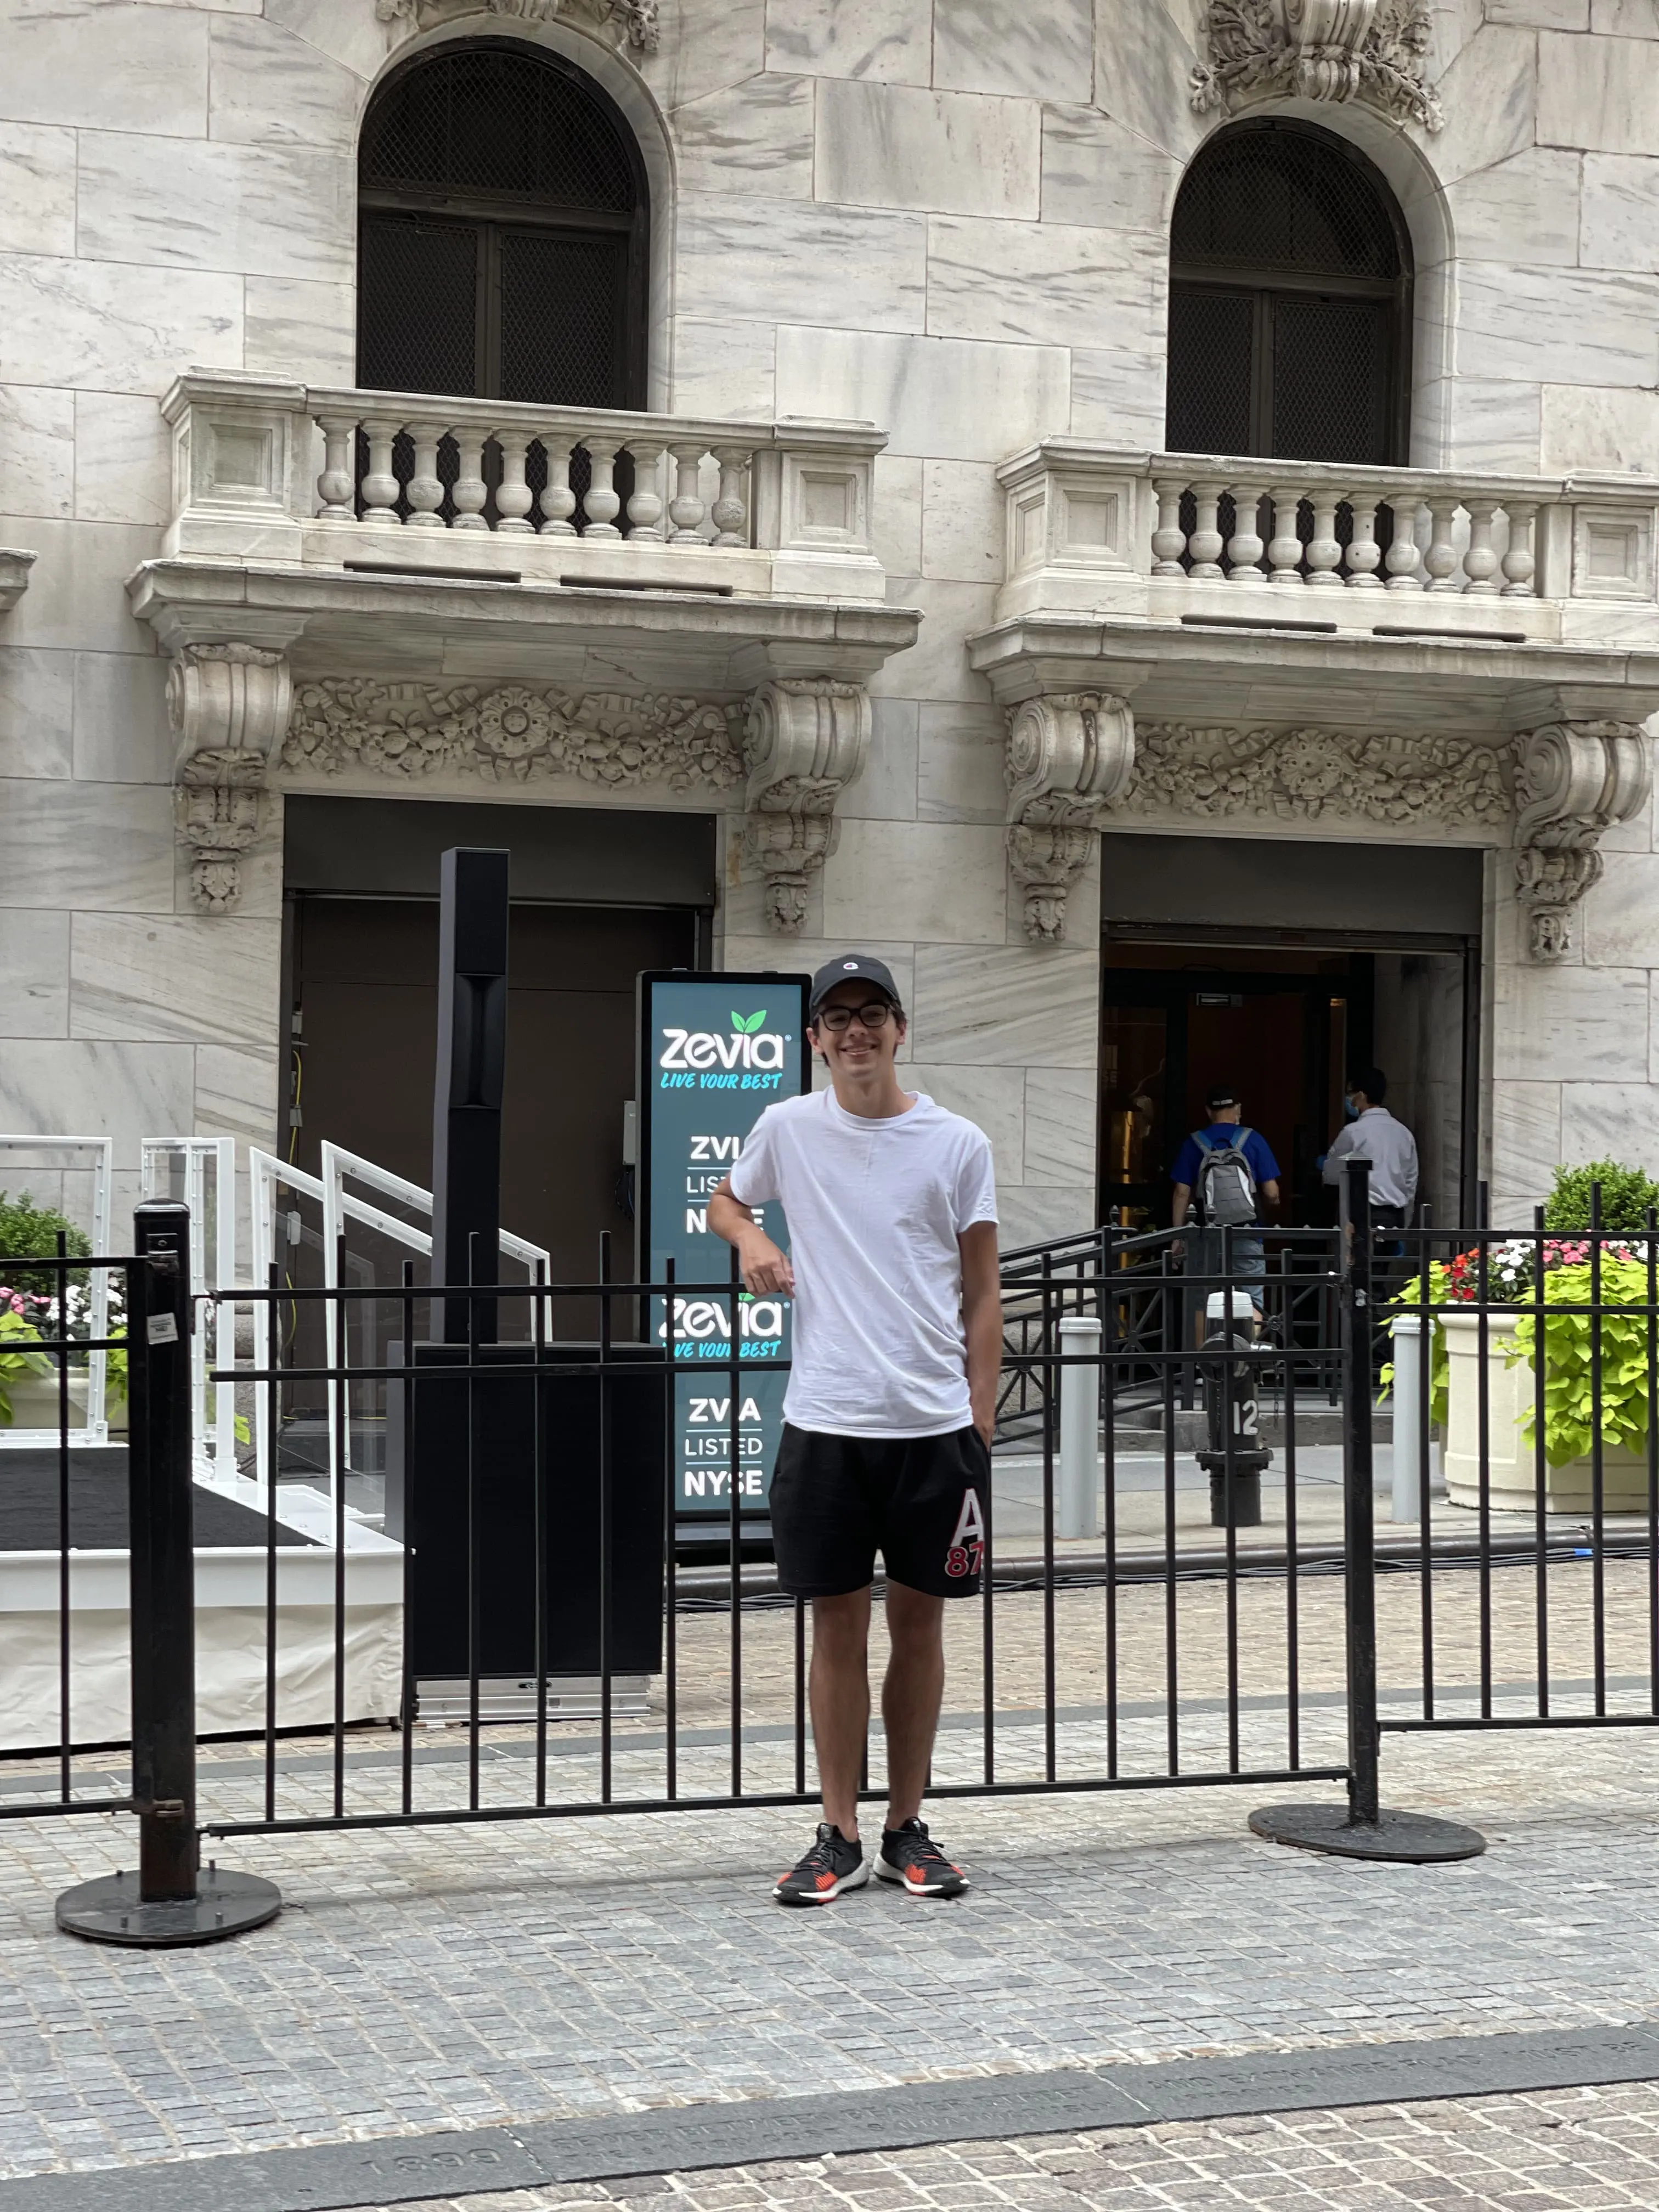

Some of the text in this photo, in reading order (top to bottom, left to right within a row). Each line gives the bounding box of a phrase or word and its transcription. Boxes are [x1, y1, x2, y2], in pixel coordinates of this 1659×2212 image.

[660, 1071, 783, 1090] LIVE YOUR BEST
[690, 1136, 740, 1160] ZVI
[686, 1208, 764, 1234] NE
[739, 1340, 782, 1358] BEST
[689, 1397, 762, 1423] ZVA
[1233, 1399, 1259, 1435] 12
[685, 1437, 763, 1456] LISTED
[950, 1487, 984, 1548] A
[944, 1541, 985, 1578] 87
